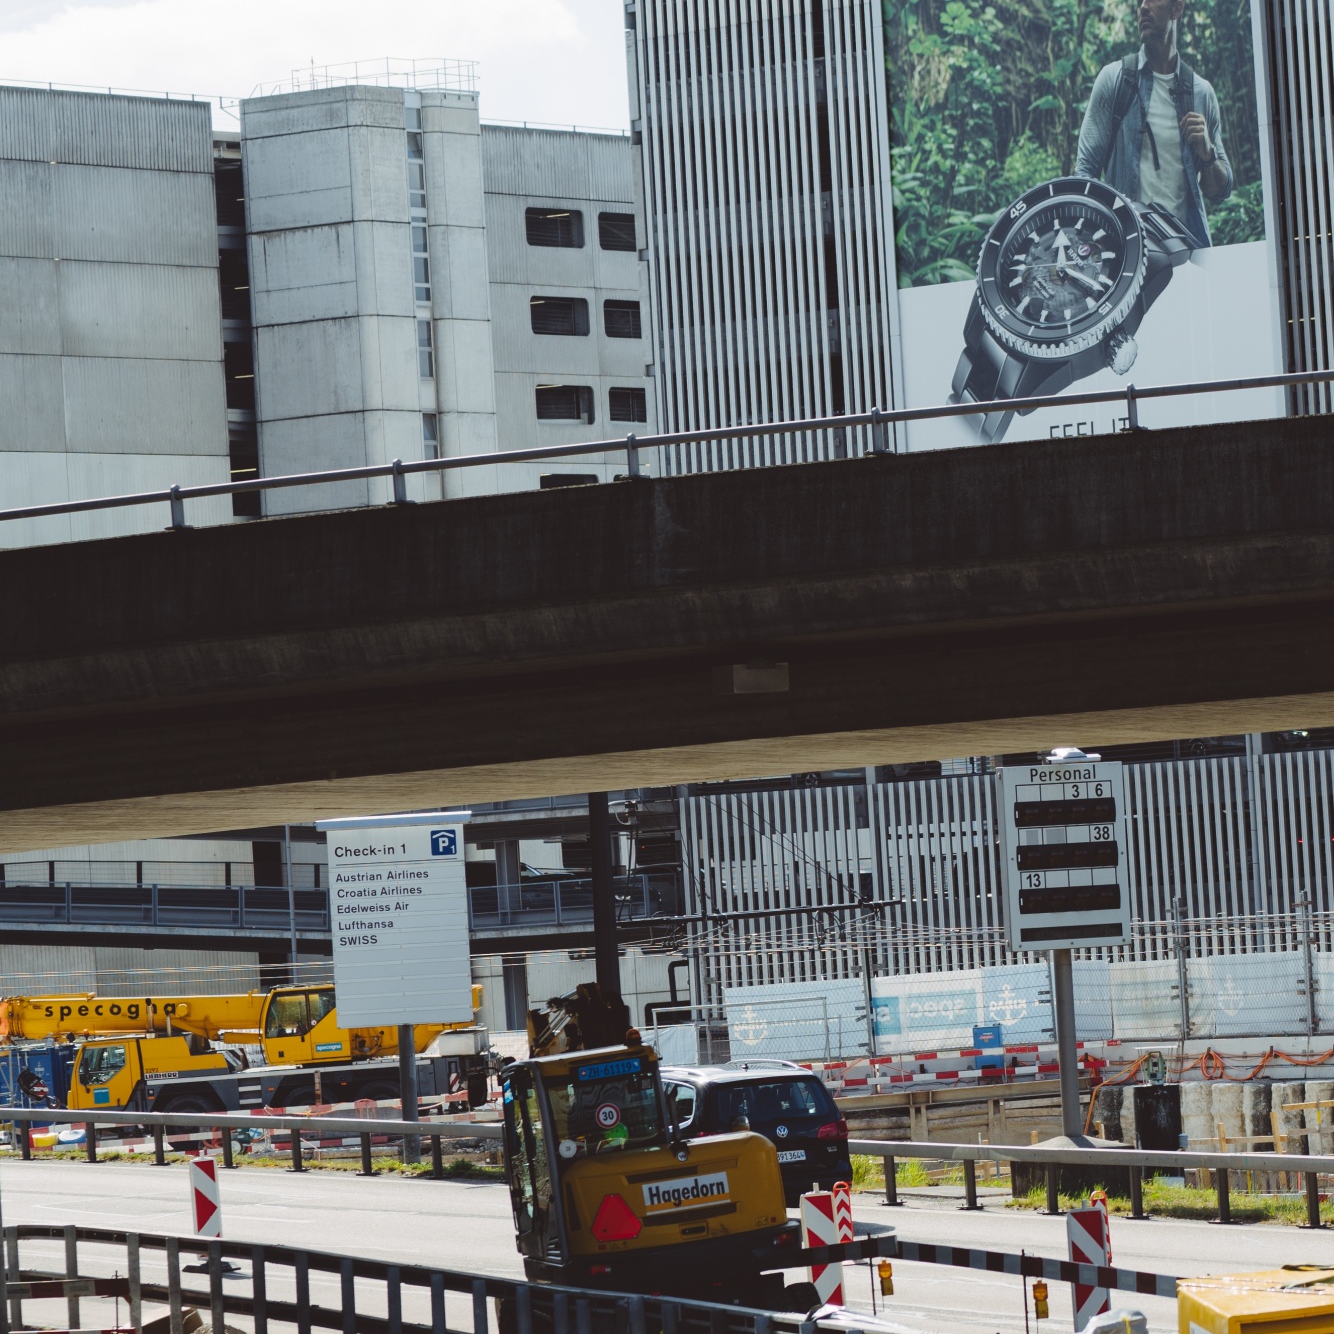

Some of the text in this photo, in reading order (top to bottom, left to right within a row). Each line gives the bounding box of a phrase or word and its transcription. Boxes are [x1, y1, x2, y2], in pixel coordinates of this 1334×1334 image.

[1010, 200, 1027, 219] 45
[1030, 764, 1096, 782] Personal
[1072, 783, 1103, 798] 3 6
[1094, 826, 1110, 840] 38
[334, 843, 406, 858] Check-in 1
[439, 837, 449, 852] P
[335, 870, 429, 883] Austrian Airlines
[1026, 873, 1041, 888] 13
[337, 886, 422, 898] Croatia Airlines
[337, 901, 409, 914] Edelweiss Air
[338, 920, 394, 931] Lufthansa
[339, 934, 378, 946] SWISS
[602, 1110, 614, 1121] 30
[648, 1178, 725, 1207] Hagedorn
